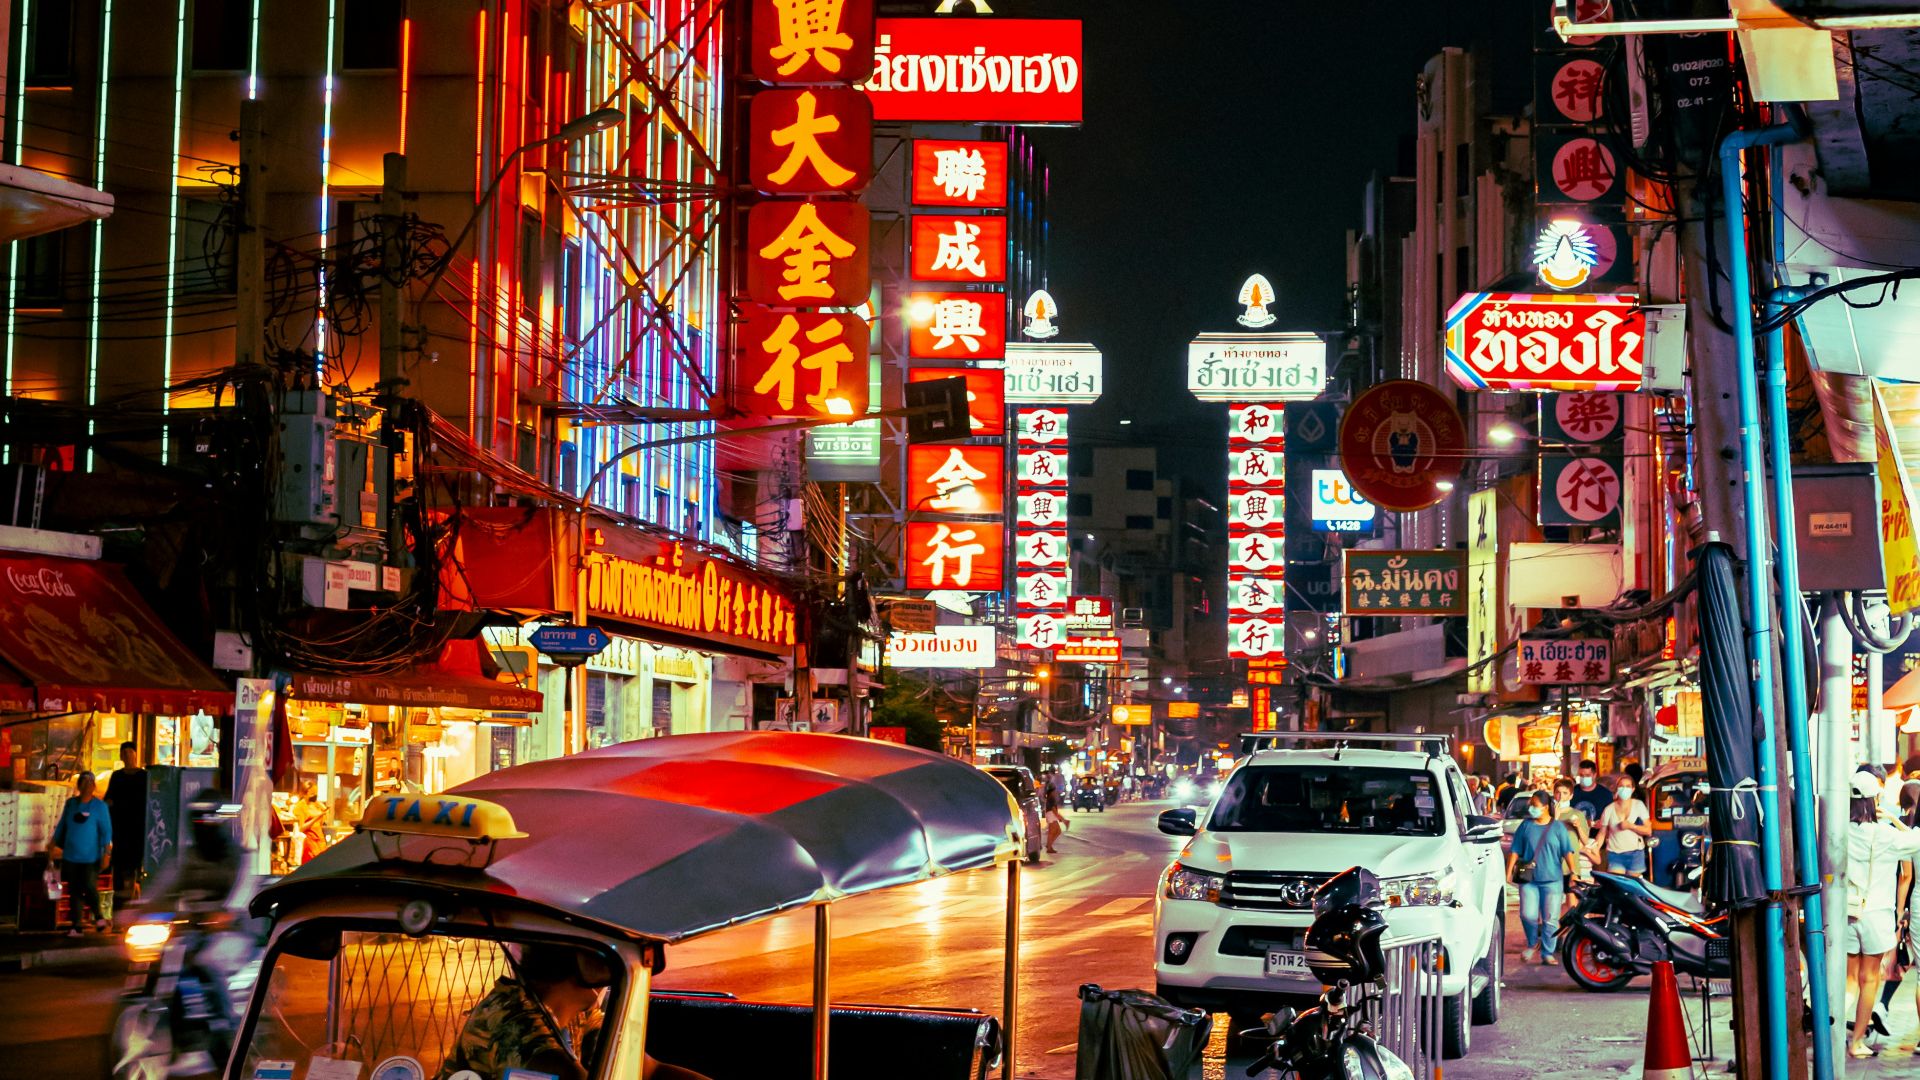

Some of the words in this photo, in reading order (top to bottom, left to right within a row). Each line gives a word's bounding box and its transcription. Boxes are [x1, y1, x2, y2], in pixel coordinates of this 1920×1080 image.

[853, 34, 1079, 94] ลี่ยงเซ่งเฮง
[1690, 76, 1711, 87] 072
[1482, 303, 1574, 329] ห้างทอง
[923, 147, 987, 587] 聯成興金行
[1197, 352, 1318, 387] ฮั่วเซ่งเฮง
[814, 442, 872, 450] WISDOM
[1030, 414, 1057, 644] 和成興大金行
[1242, 409, 1270, 644] 和成興大金行
[1335, 521, 1361, 531] 1428
[7, 566, 76, 596] Coca-Cola
[1352, 555, 1458, 591] ฉ.มั่นคง
[588, 633, 597, 646] 6
[384, 797, 477, 828] TAXI
